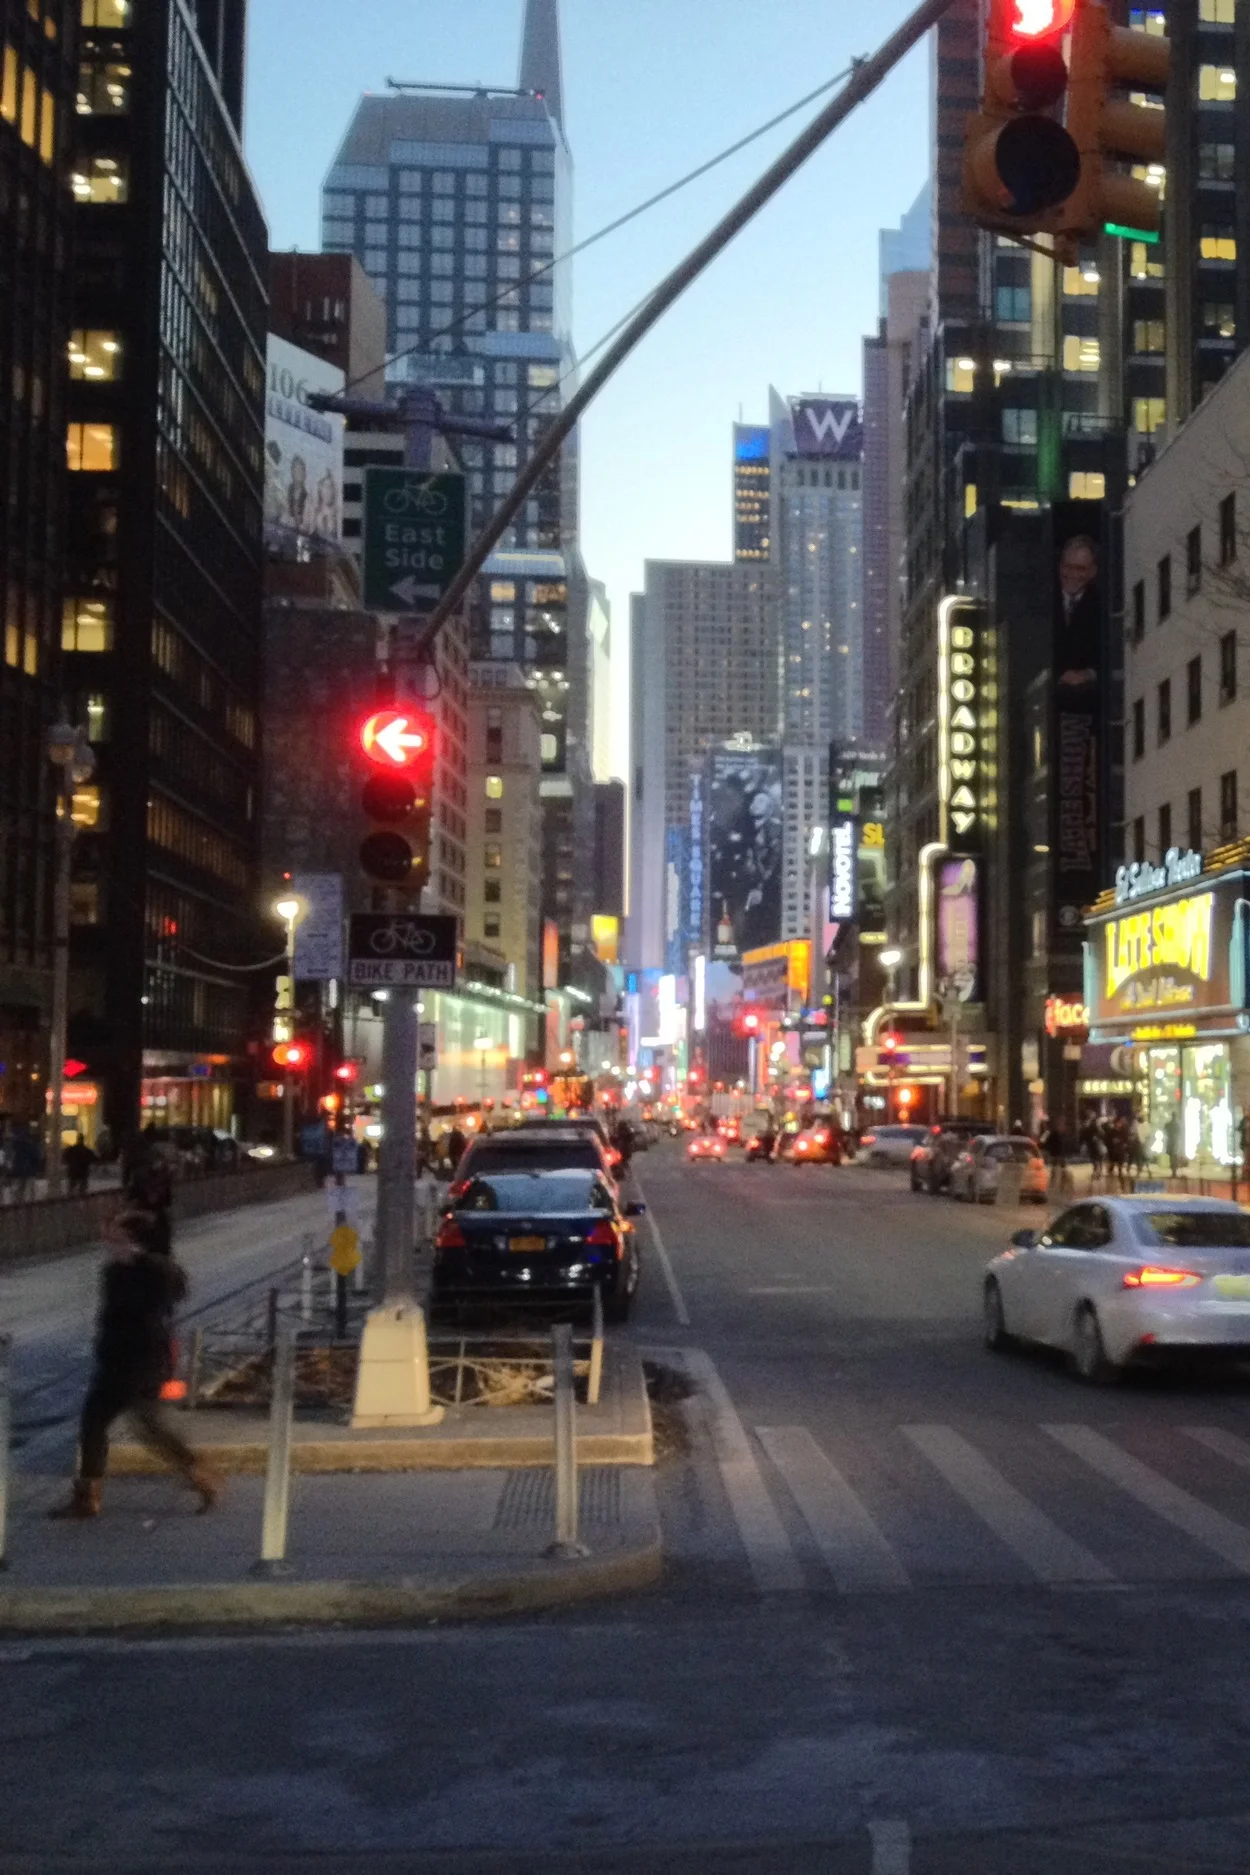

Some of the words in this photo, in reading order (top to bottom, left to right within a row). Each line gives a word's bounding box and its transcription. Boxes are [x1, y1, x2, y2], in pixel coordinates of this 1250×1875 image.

[805, 407, 853, 442] W
[385, 524, 445, 544] East
[385, 547, 444, 570] Side
[950, 626, 977, 834] BROADWAY
[832, 821, 853, 917] NOVOTEL
[354, 960, 396, 981] BIKE
[403, 961, 449, 982] PATH
[1105, 911, 1151, 1000] LATE
